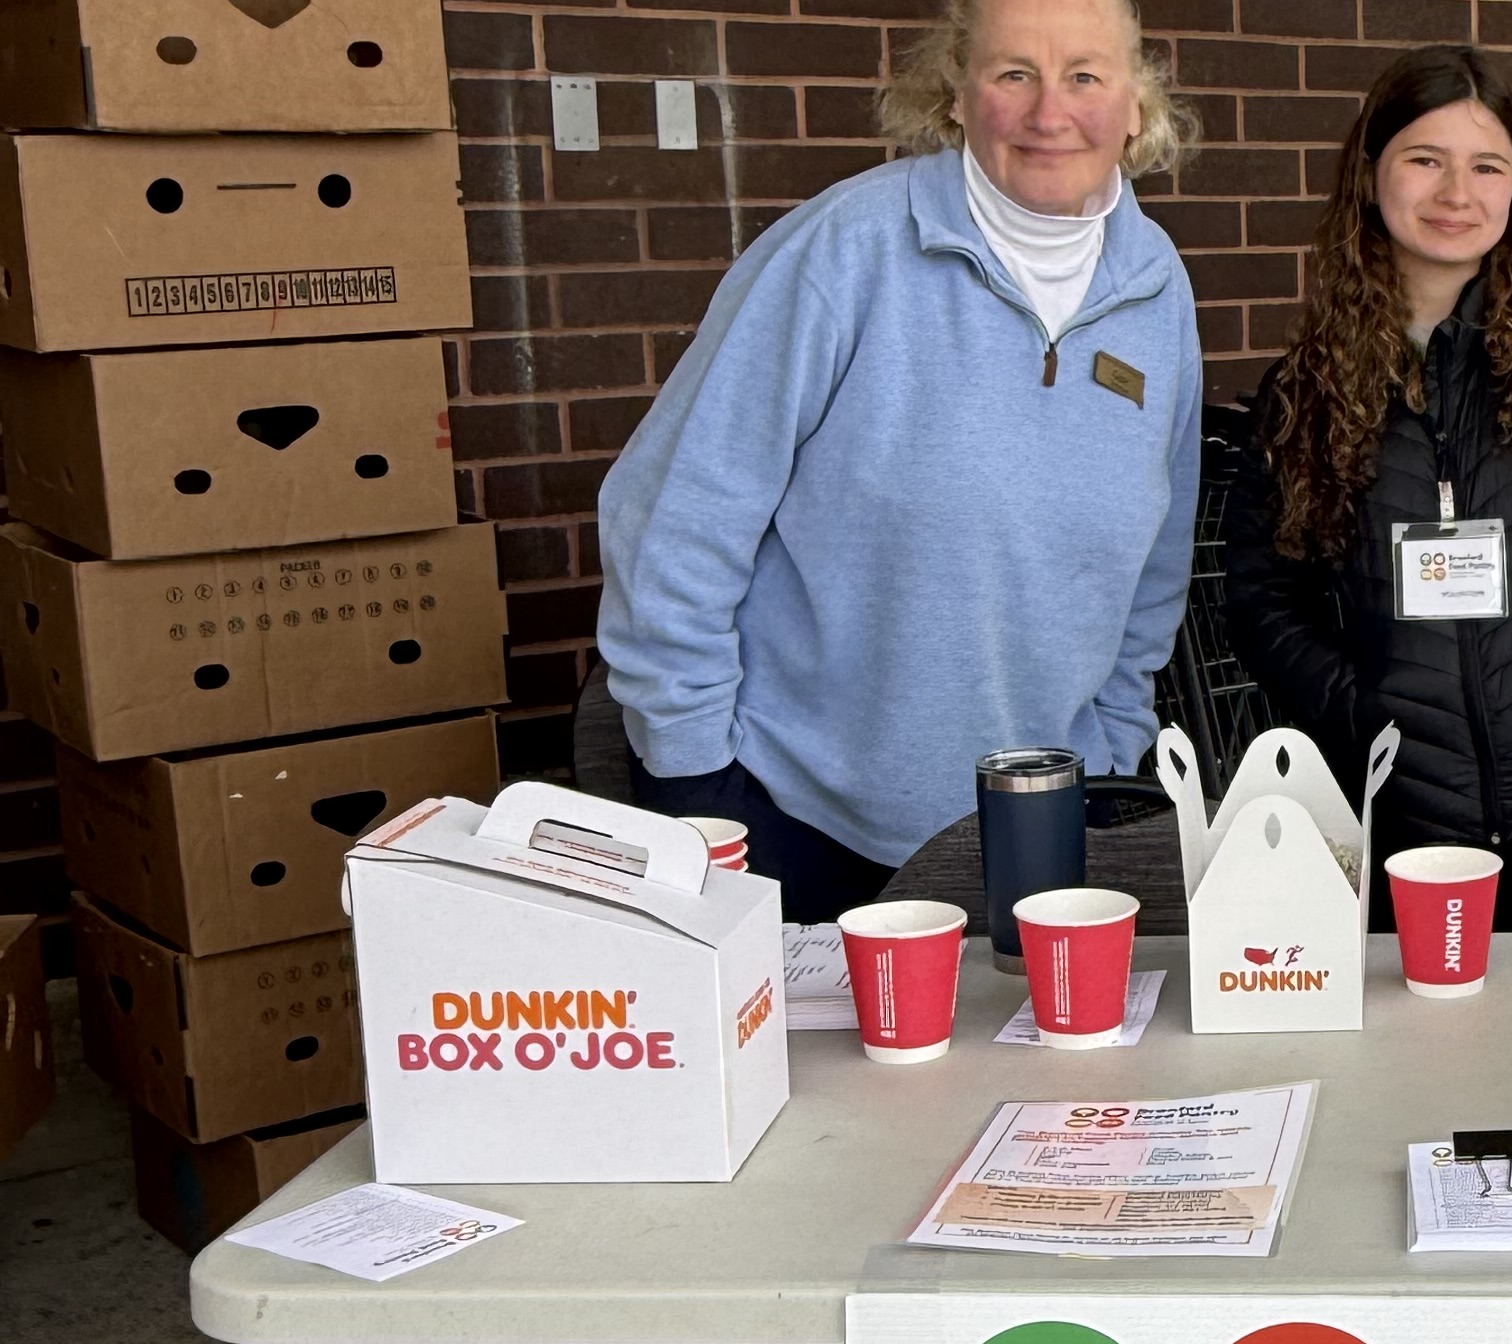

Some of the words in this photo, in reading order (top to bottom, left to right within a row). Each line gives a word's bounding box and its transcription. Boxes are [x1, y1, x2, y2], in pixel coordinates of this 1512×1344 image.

[134, 287, 142, 307] 1
[151, 286, 162, 307] 2
[170, 285, 180, 306] 3
[189, 285, 198, 306] 4
[206, 282, 217, 304] 5
[224, 282, 235, 303] 6
[242, 282, 251, 303] 7
[278, 279, 287, 301] 9
[312, 277, 324, 301] 11
[328, 277, 342, 298] 12
[1444, 899, 1463, 973] DUNKIN'
[1219, 970, 1330, 992] DUNKIN'
[432, 990, 637, 1030] DUNKIN'
[398, 1032, 502, 1071] BOX
